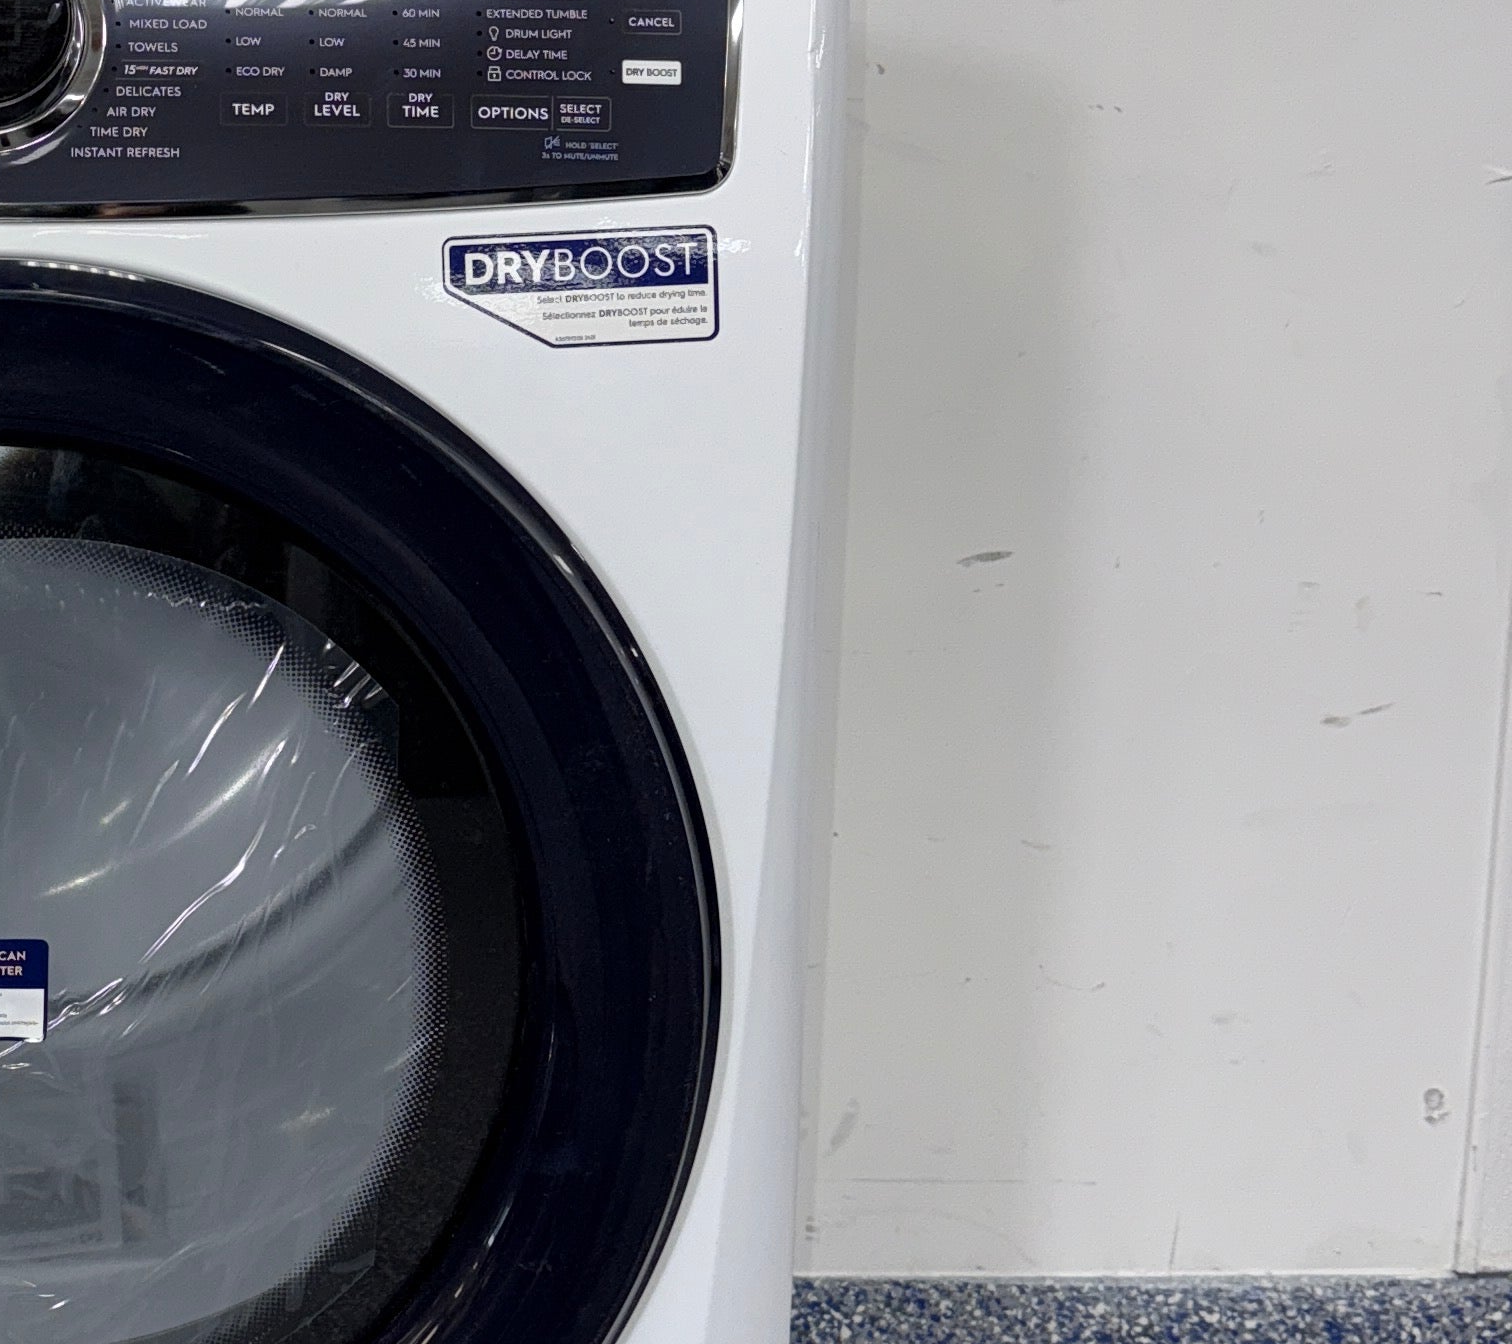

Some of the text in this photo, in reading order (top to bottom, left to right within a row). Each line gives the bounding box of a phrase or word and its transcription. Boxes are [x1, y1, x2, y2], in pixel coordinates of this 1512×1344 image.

[236, 8, 284, 17] NORMAL
[319, 8, 367, 17] NORMAL
[402, 9, 440, 17] 60 MIN
[487, 9, 587, 19] EXTENDED TUMBLE
[130, 19, 207, 29] MIXED LOAD
[629, 17, 674, 27] CANCEL
[506, 29, 572, 39] DRUM LIGHT
[236, 37, 261, 46] LOW
[320, 38, 345, 47] LOW
[403, 38, 440, 48] 45 MIN
[128, 42, 178, 52] TOWELS
[506, 50, 567, 59] DELAY TIME
[149, 66, 175, 75] FAST
[176, 66, 199, 75] DRY
[237, 67, 285, 76] ECO DRY
[320, 68, 352, 77] DAMP
[403, 68, 441, 78] 30 MIN
[506, 70, 591, 80] CONTROL LOCK
[626, 68, 677, 78] DRY BOOST
[116, 86, 181, 96] DELICATES
[325, 92, 349, 101] DRY
[409, 93, 432, 102] DRY
[107, 107, 156, 117] AIR DRY
[232, 103, 274, 115] TEMP
[315, 104, 360, 116] LEVEL
[402, 106, 439, 117] TIME
[478, 107, 548, 119] OPTIONS
[560, 104, 601, 114] SELECT
[561, 116, 600, 124] DE-SELECT
[90, 127, 148, 137] TIME DRY
[71, 147, 179, 158] INSTANT REFRESH
[464, 242, 698, 286] DRYBOOST
[565, 293, 614, 303] DRYBOOST
[628, 291, 656, 300] reduce
[659, 290, 686, 300] drying
[657, 318, 668, 326] de
